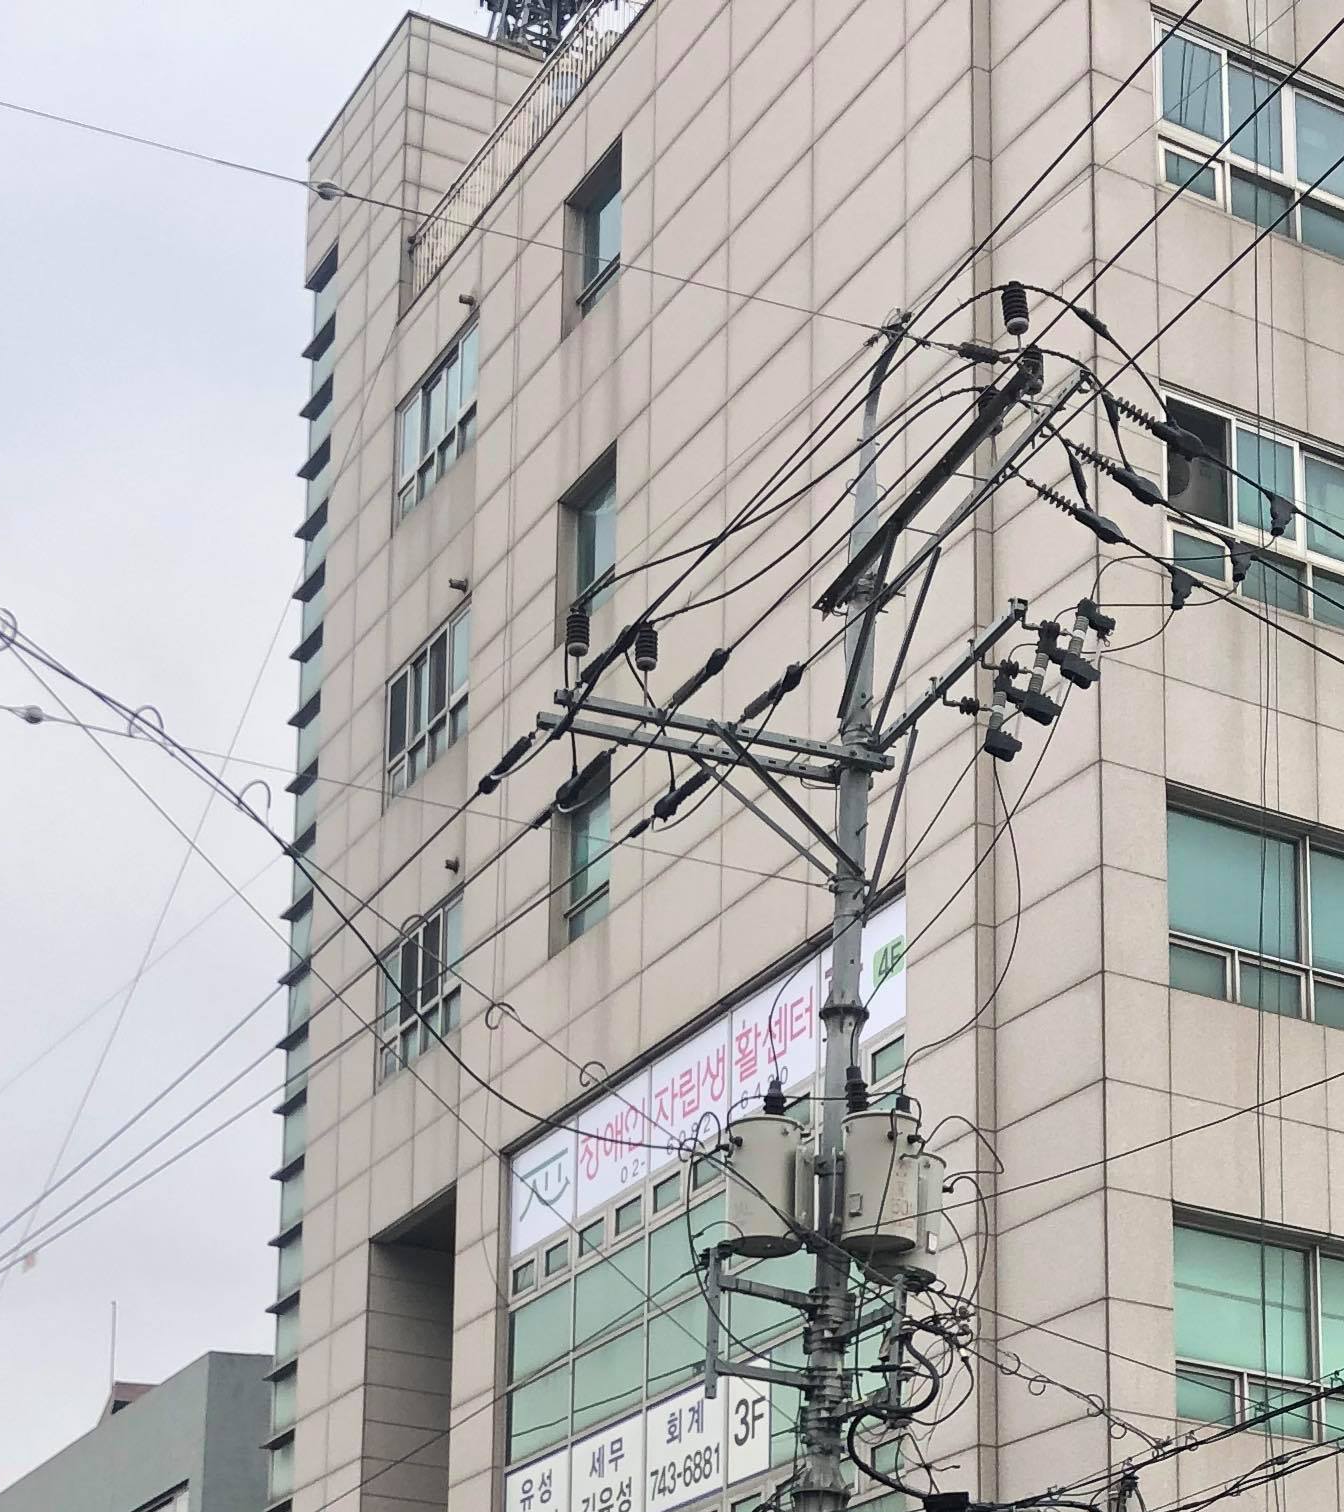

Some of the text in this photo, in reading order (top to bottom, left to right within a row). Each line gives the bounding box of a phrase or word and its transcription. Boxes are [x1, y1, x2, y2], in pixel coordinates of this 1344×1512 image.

[878, 940, 903, 978] 4F
[734, 1396, 766, 1446] 3F
[650, 1443, 720, 1501] 743-6881
